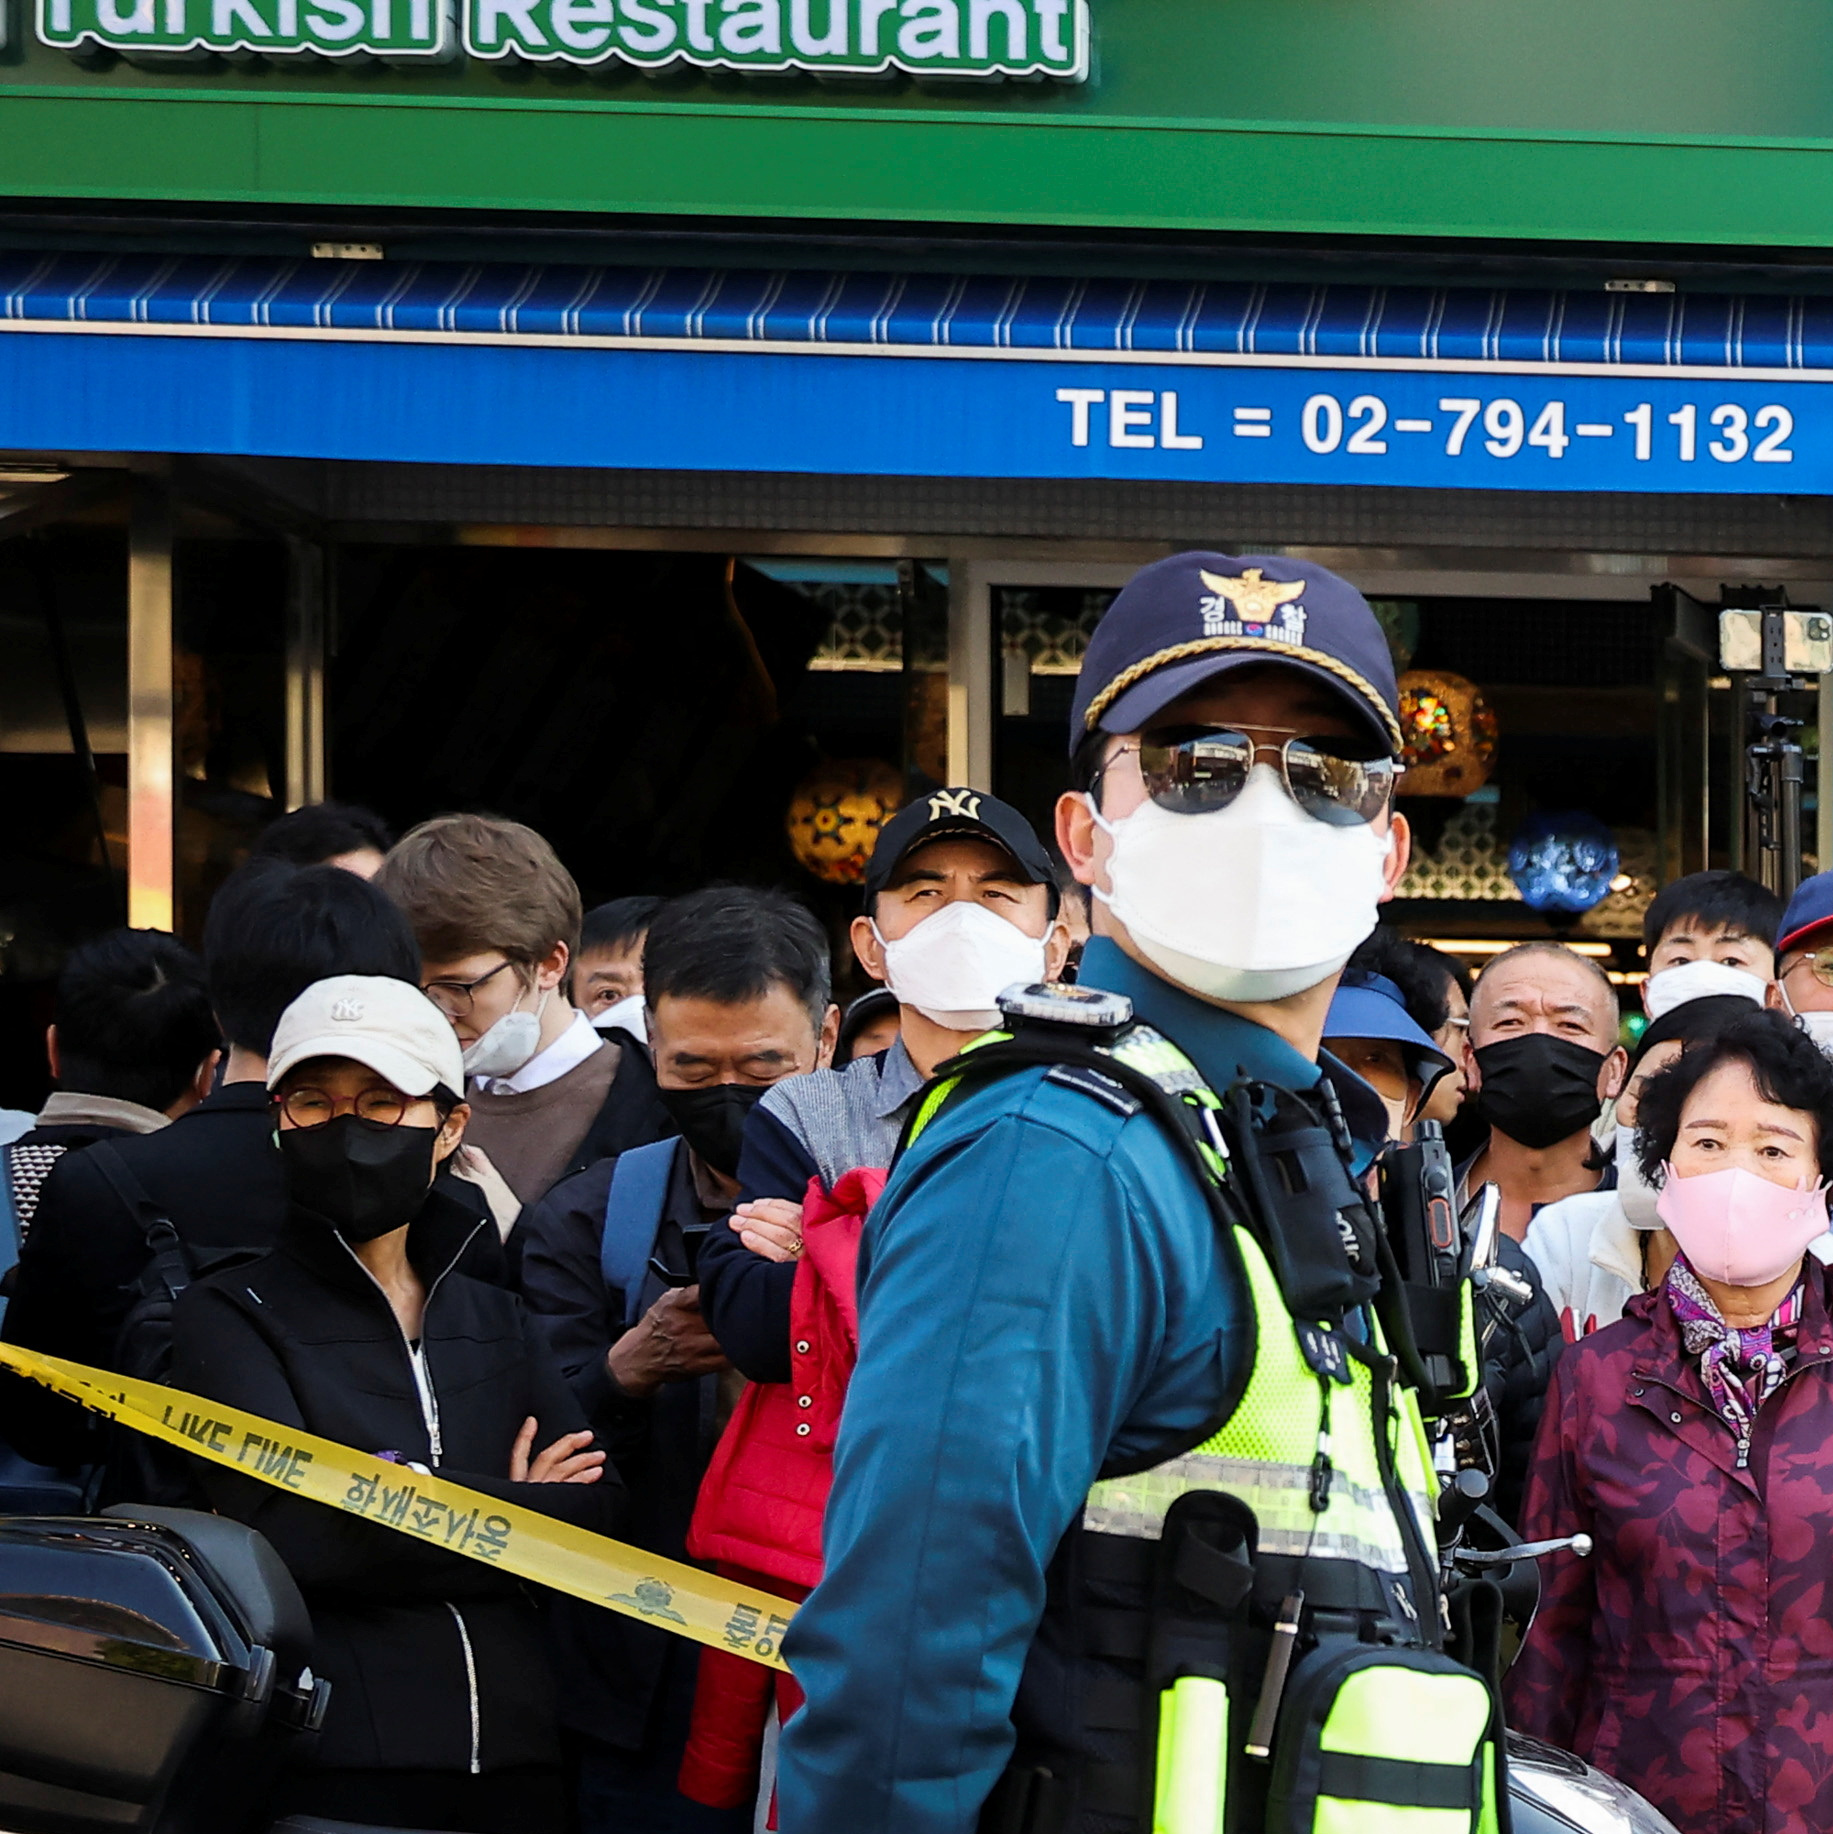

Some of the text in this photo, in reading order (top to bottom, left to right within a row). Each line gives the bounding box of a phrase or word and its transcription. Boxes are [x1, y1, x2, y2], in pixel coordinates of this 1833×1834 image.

[478, 0, 1073, 62] Restaurant
[1056, 387, 1202, 450] TEL
[1301, 391, 1795, 465] 02-794-1132
